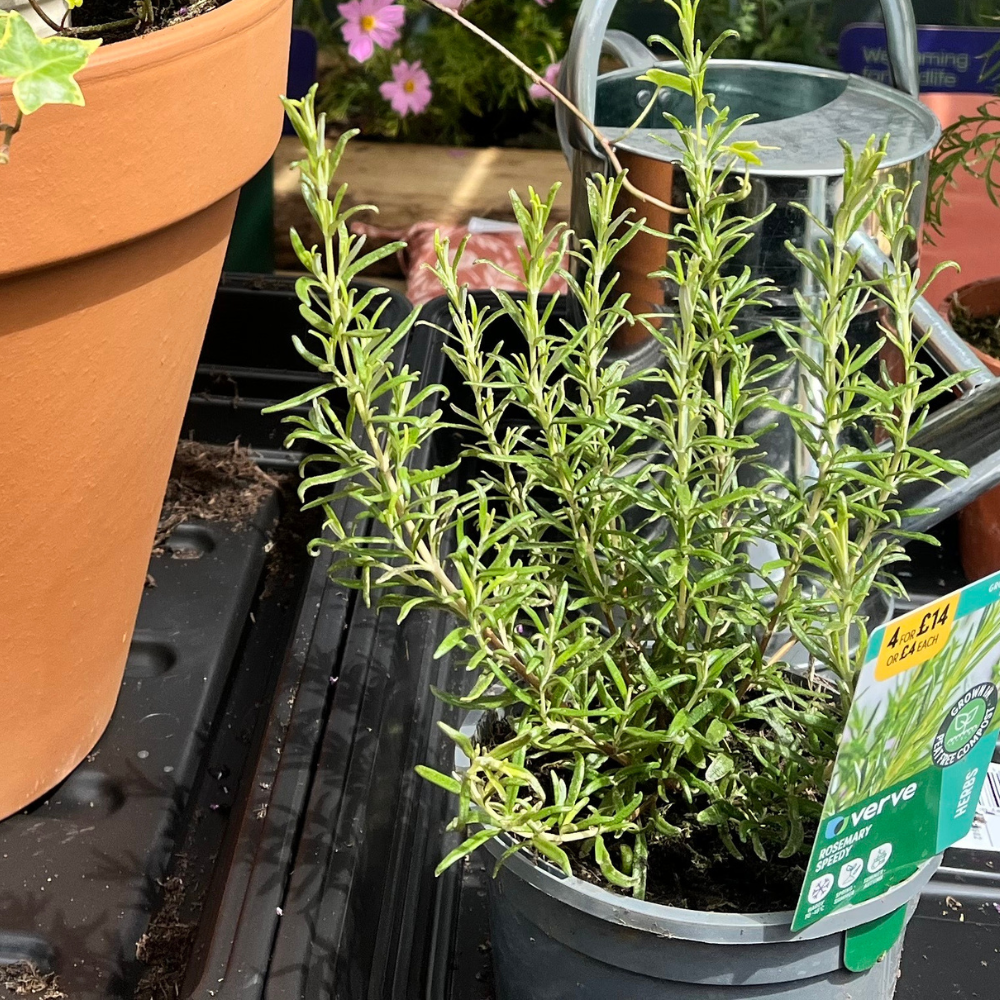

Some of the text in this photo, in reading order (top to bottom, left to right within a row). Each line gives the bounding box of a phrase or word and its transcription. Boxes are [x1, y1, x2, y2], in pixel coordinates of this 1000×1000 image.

[862, 46, 969, 73] Weming
[917, 69, 958, 87] dlife
[887, 603, 950, 649] 4 FOR £14
[886, 633, 940, 667] OR £4 EACH
[950, 685, 986, 717] GROWN
[932, 706, 995, 766] PEAT FREE COMPOST
[851, 782, 918, 827] verve
[954, 767, 979, 819] HERBS
[815, 845, 854, 873] SPEEDY
[818, 824, 873, 860] ROSEMARY
